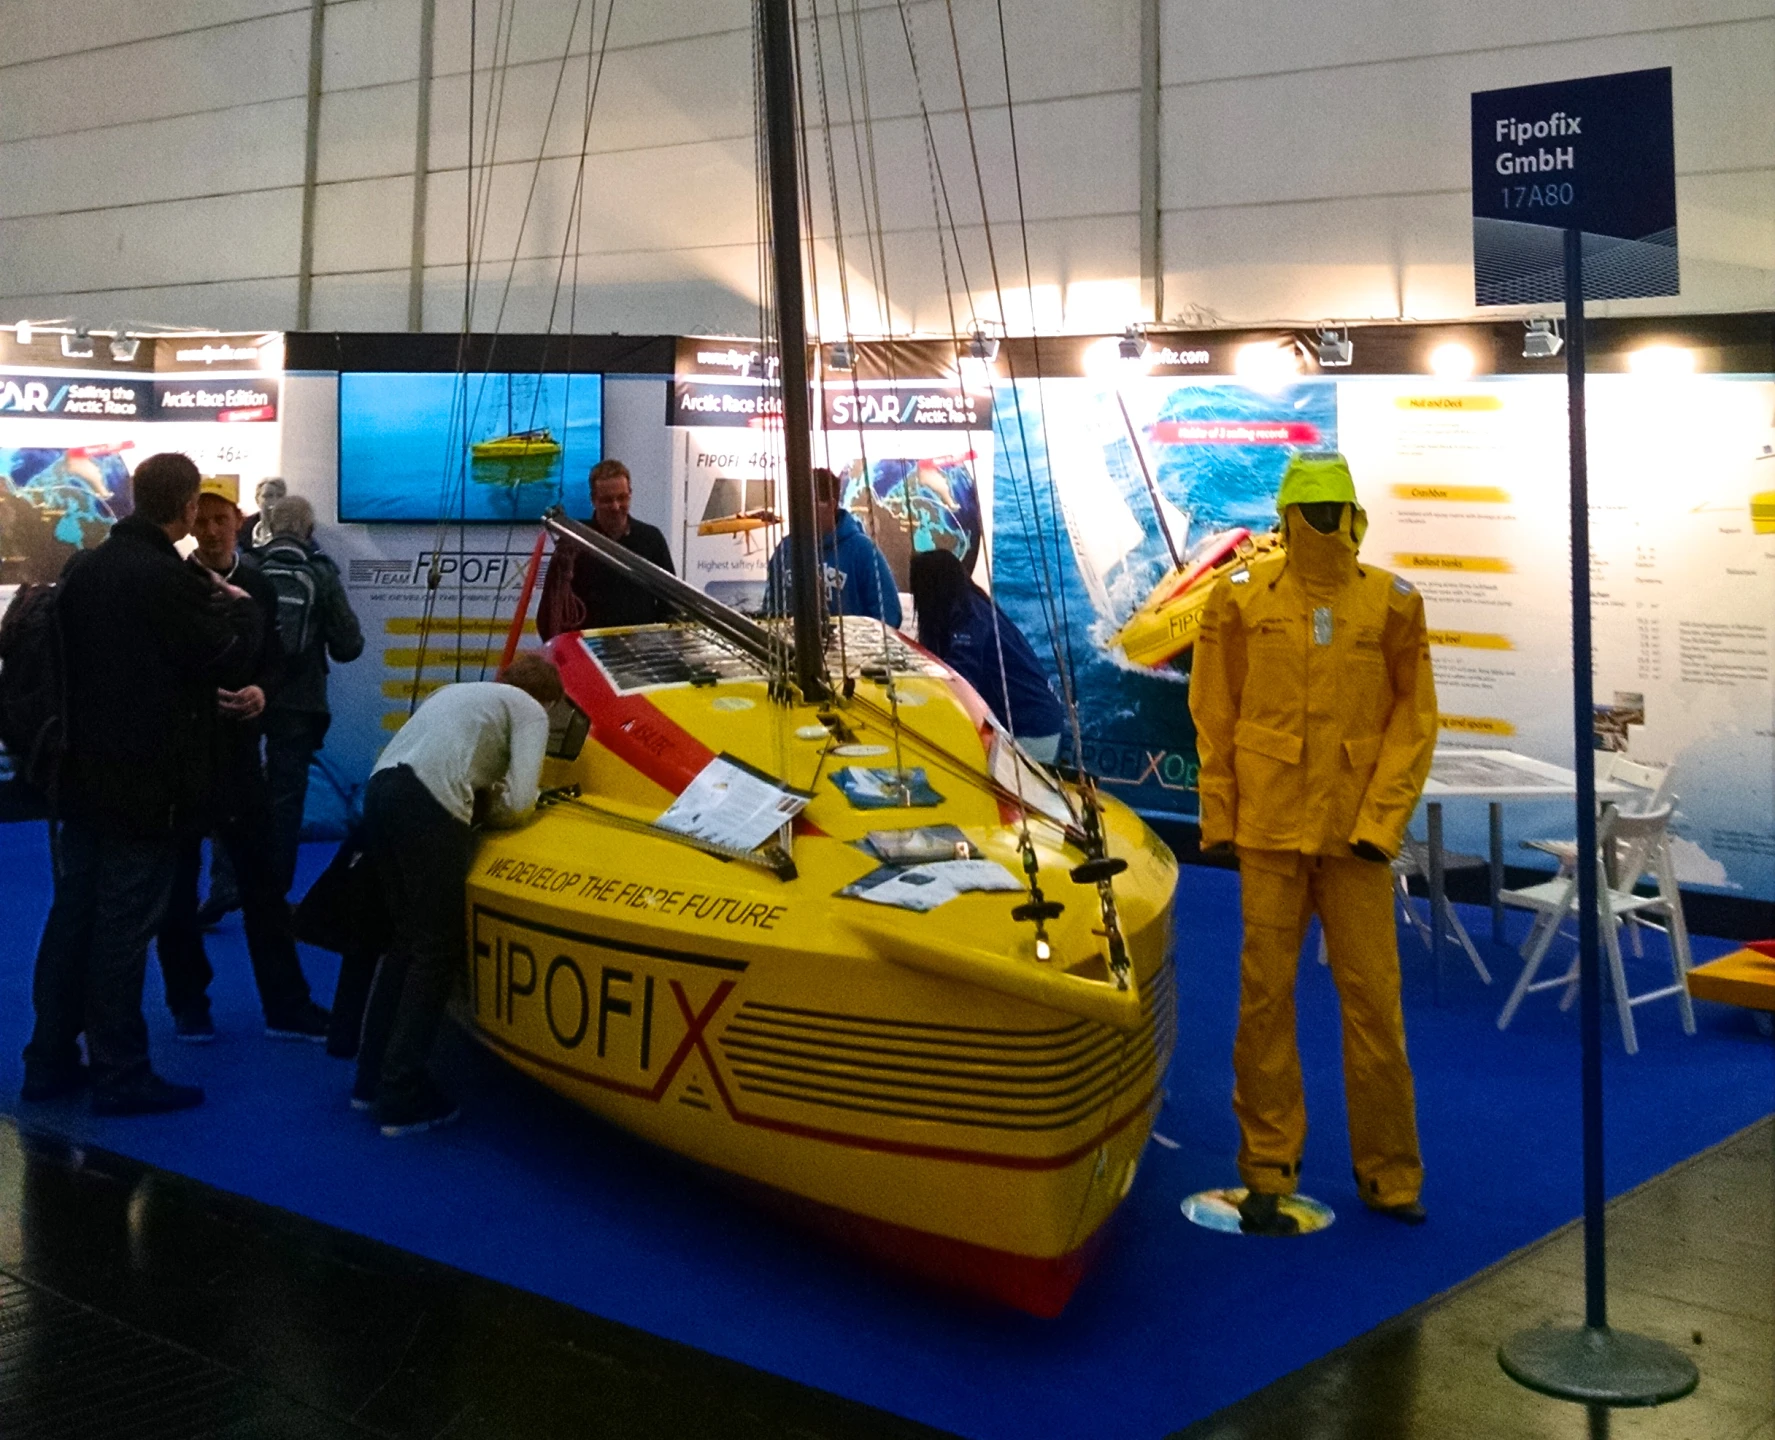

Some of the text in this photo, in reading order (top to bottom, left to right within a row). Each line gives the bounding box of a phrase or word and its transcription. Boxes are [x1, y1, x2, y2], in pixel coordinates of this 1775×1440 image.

[1496, 112, 1582, 146] Fipofix
[1496, 146, 1574, 175] GmbH
[1501, 182, 1574, 209] 17A80
[68, 385, 135, 402] Sailing the
[161, 389, 268, 408] Arctic Race Edition
[681, 394, 721, 413] Arctic
[722, 394, 756, 413] Race
[917, 395, 954, 410] Sailing
[64, 400, 137, 414] Arctic Race
[832, 395, 901, 425] STAR
[914, 410, 948, 423] Arctic
[486, 857, 788, 930] WE DEVELOP THE FIBRE FUTURE
[472, 902, 740, 1103] FIPOFIX
